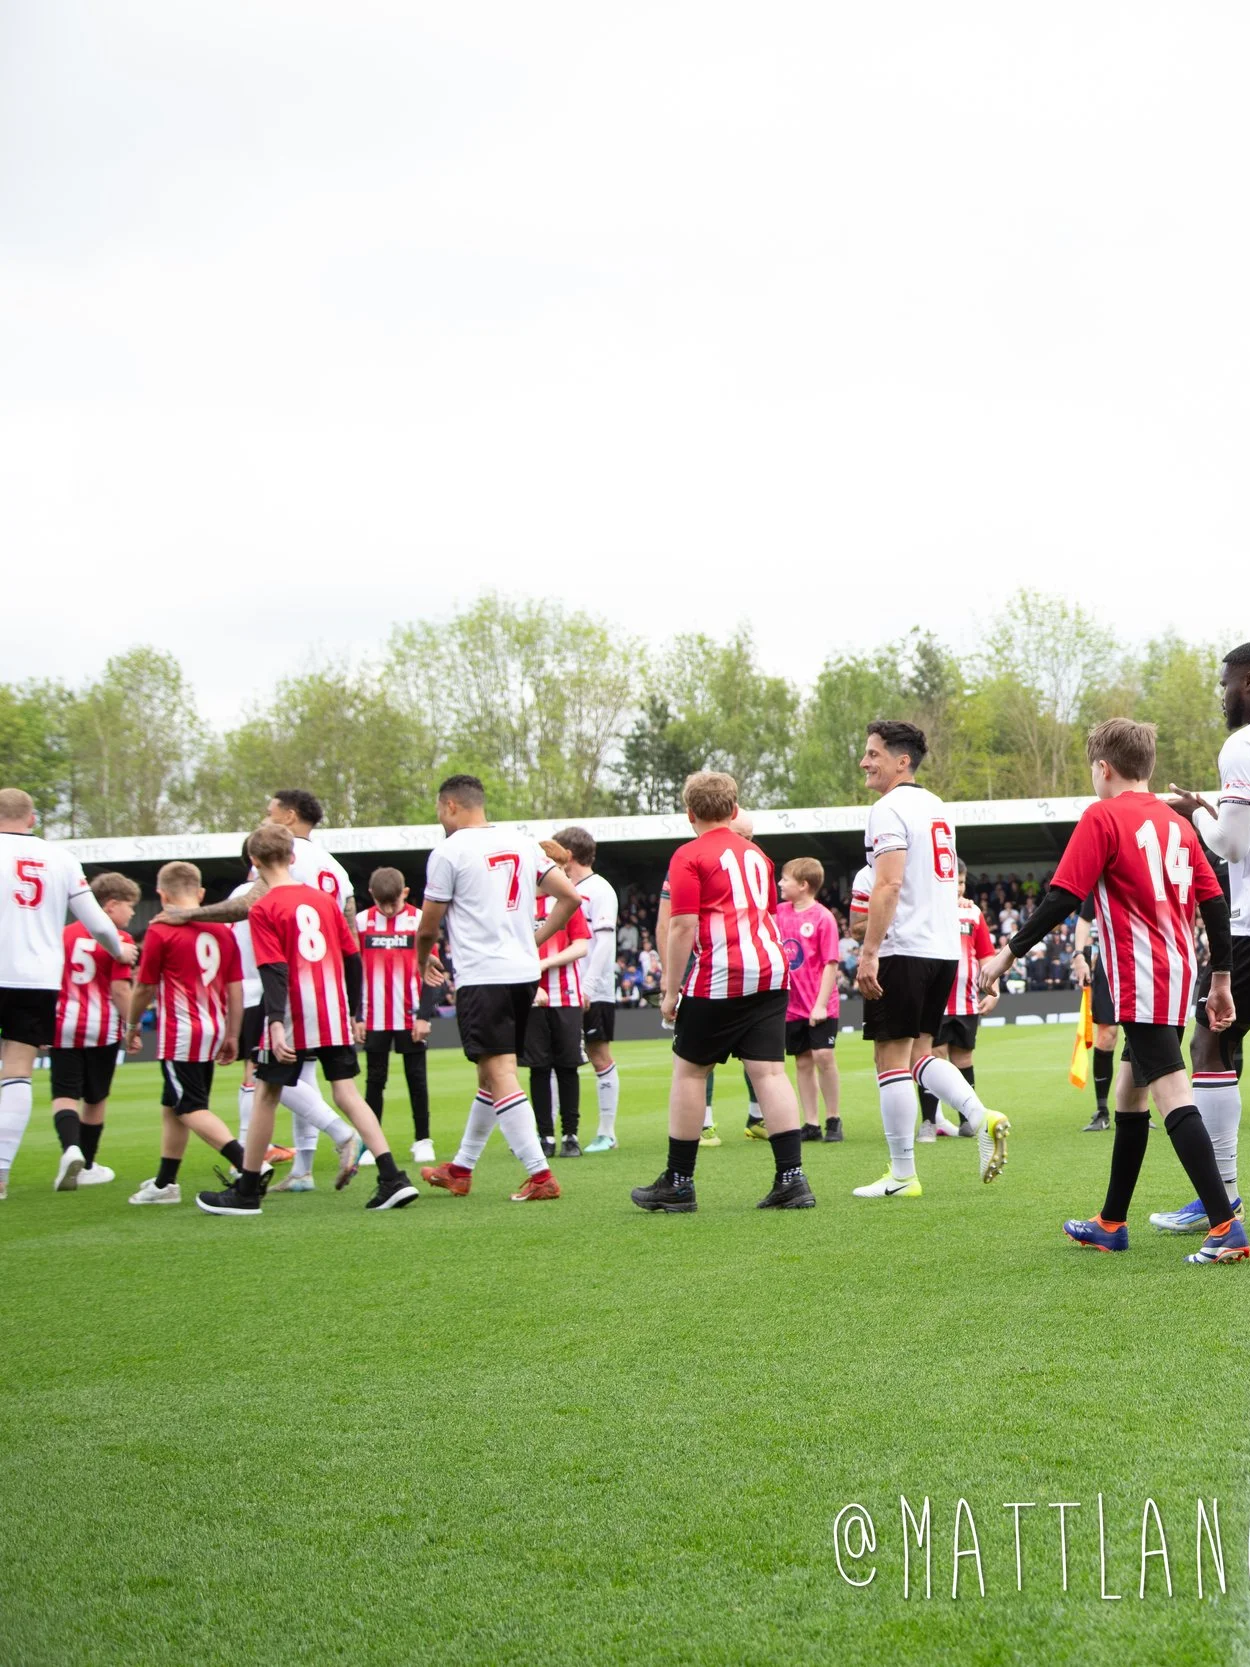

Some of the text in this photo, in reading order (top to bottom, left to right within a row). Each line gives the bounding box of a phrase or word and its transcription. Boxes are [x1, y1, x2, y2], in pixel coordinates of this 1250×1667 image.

[719, 848, 768, 910] 10
[931, 818, 958, 882] 6
[1135, 819, 1194, 904] 14
[14, 856, 47, 910] 5
[485, 850, 524, 911] 7
[71, 937, 97, 984] 5
[195, 931, 221, 987] 9
[295, 903, 327, 963] 8
